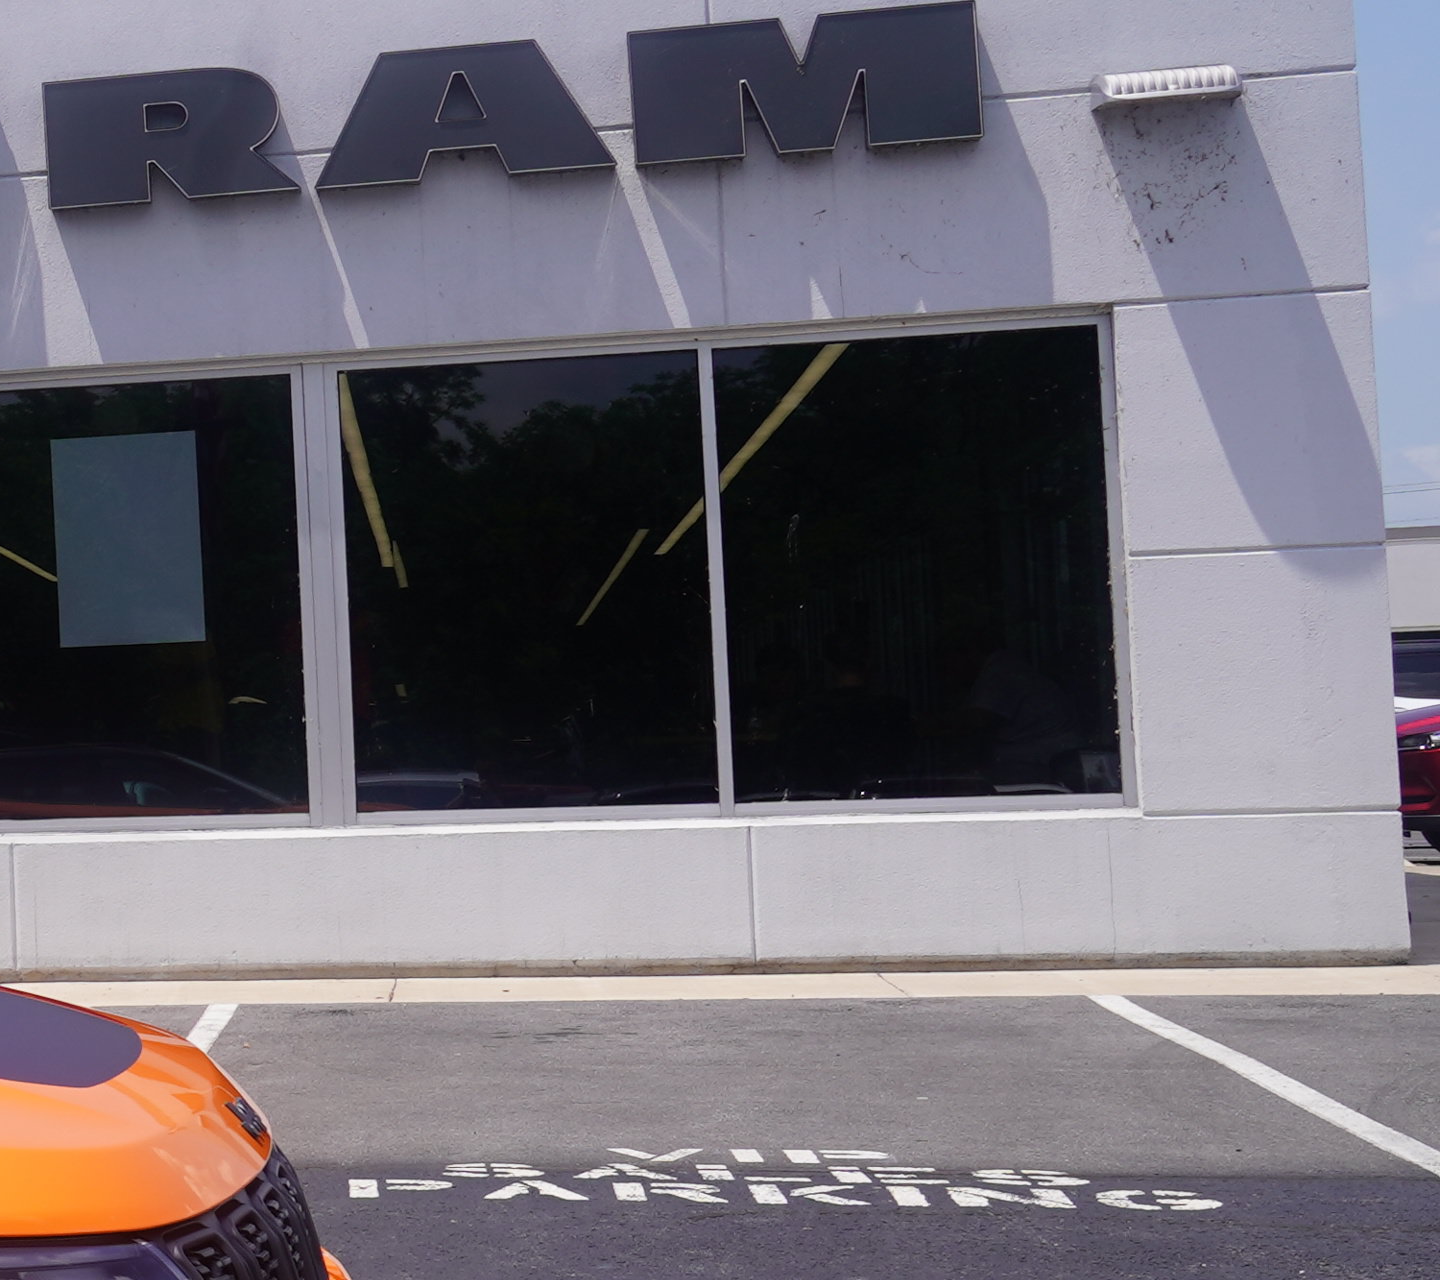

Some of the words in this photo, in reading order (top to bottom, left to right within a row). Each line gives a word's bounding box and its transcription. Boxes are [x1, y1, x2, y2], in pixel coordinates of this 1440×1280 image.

[41, 0, 985, 211] RAM
[606, 1147, 889, 1164] VIP
[442, 1162, 1091, 1187] SALES
[347, 1178, 1224, 1212] PARKING
